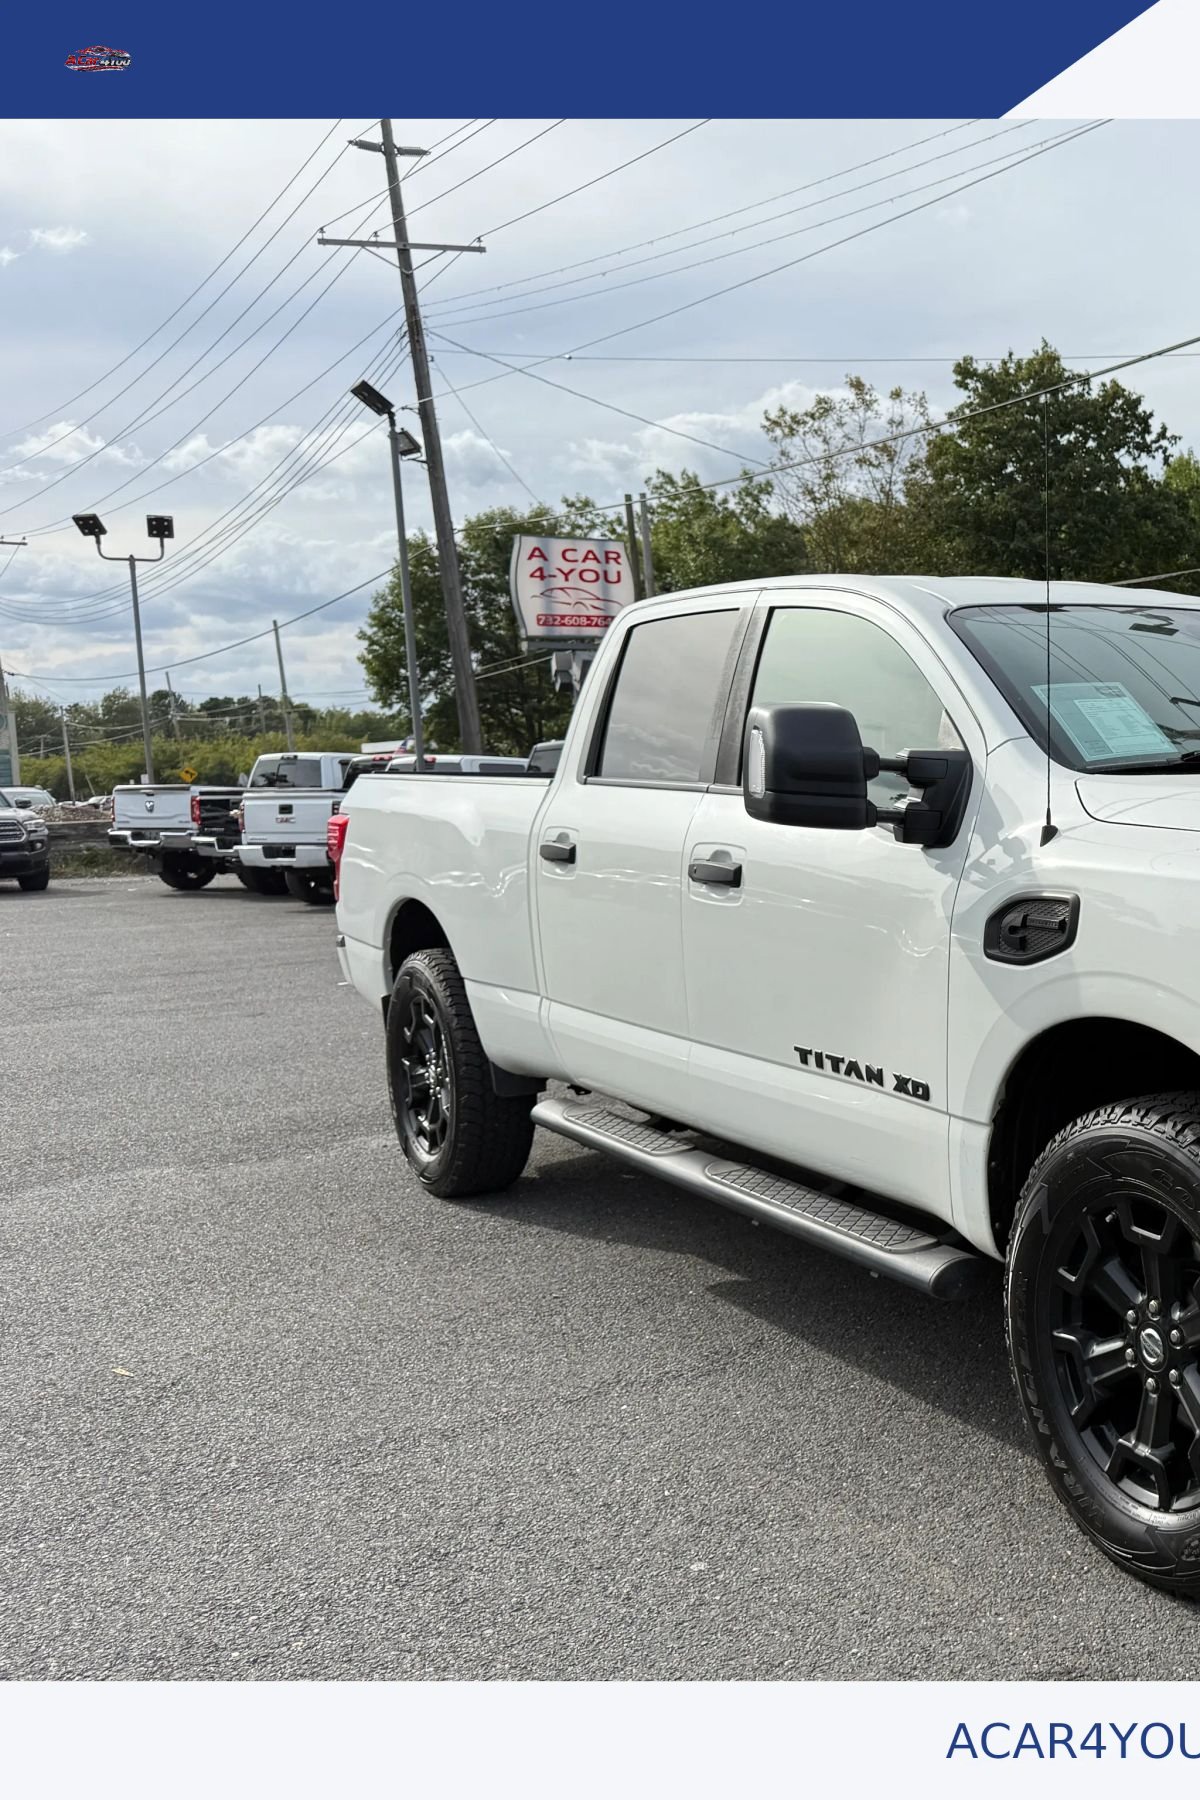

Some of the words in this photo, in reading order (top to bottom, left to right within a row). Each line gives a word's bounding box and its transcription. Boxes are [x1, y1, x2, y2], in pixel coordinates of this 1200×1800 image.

[527, 546, 549, 562] A
[561, 548, 622, 565] CAR
[529, 566, 622, 584] 4-YOU
[793, 1044, 884, 1087] TITAN
[892, 1072, 930, 1102] XD
